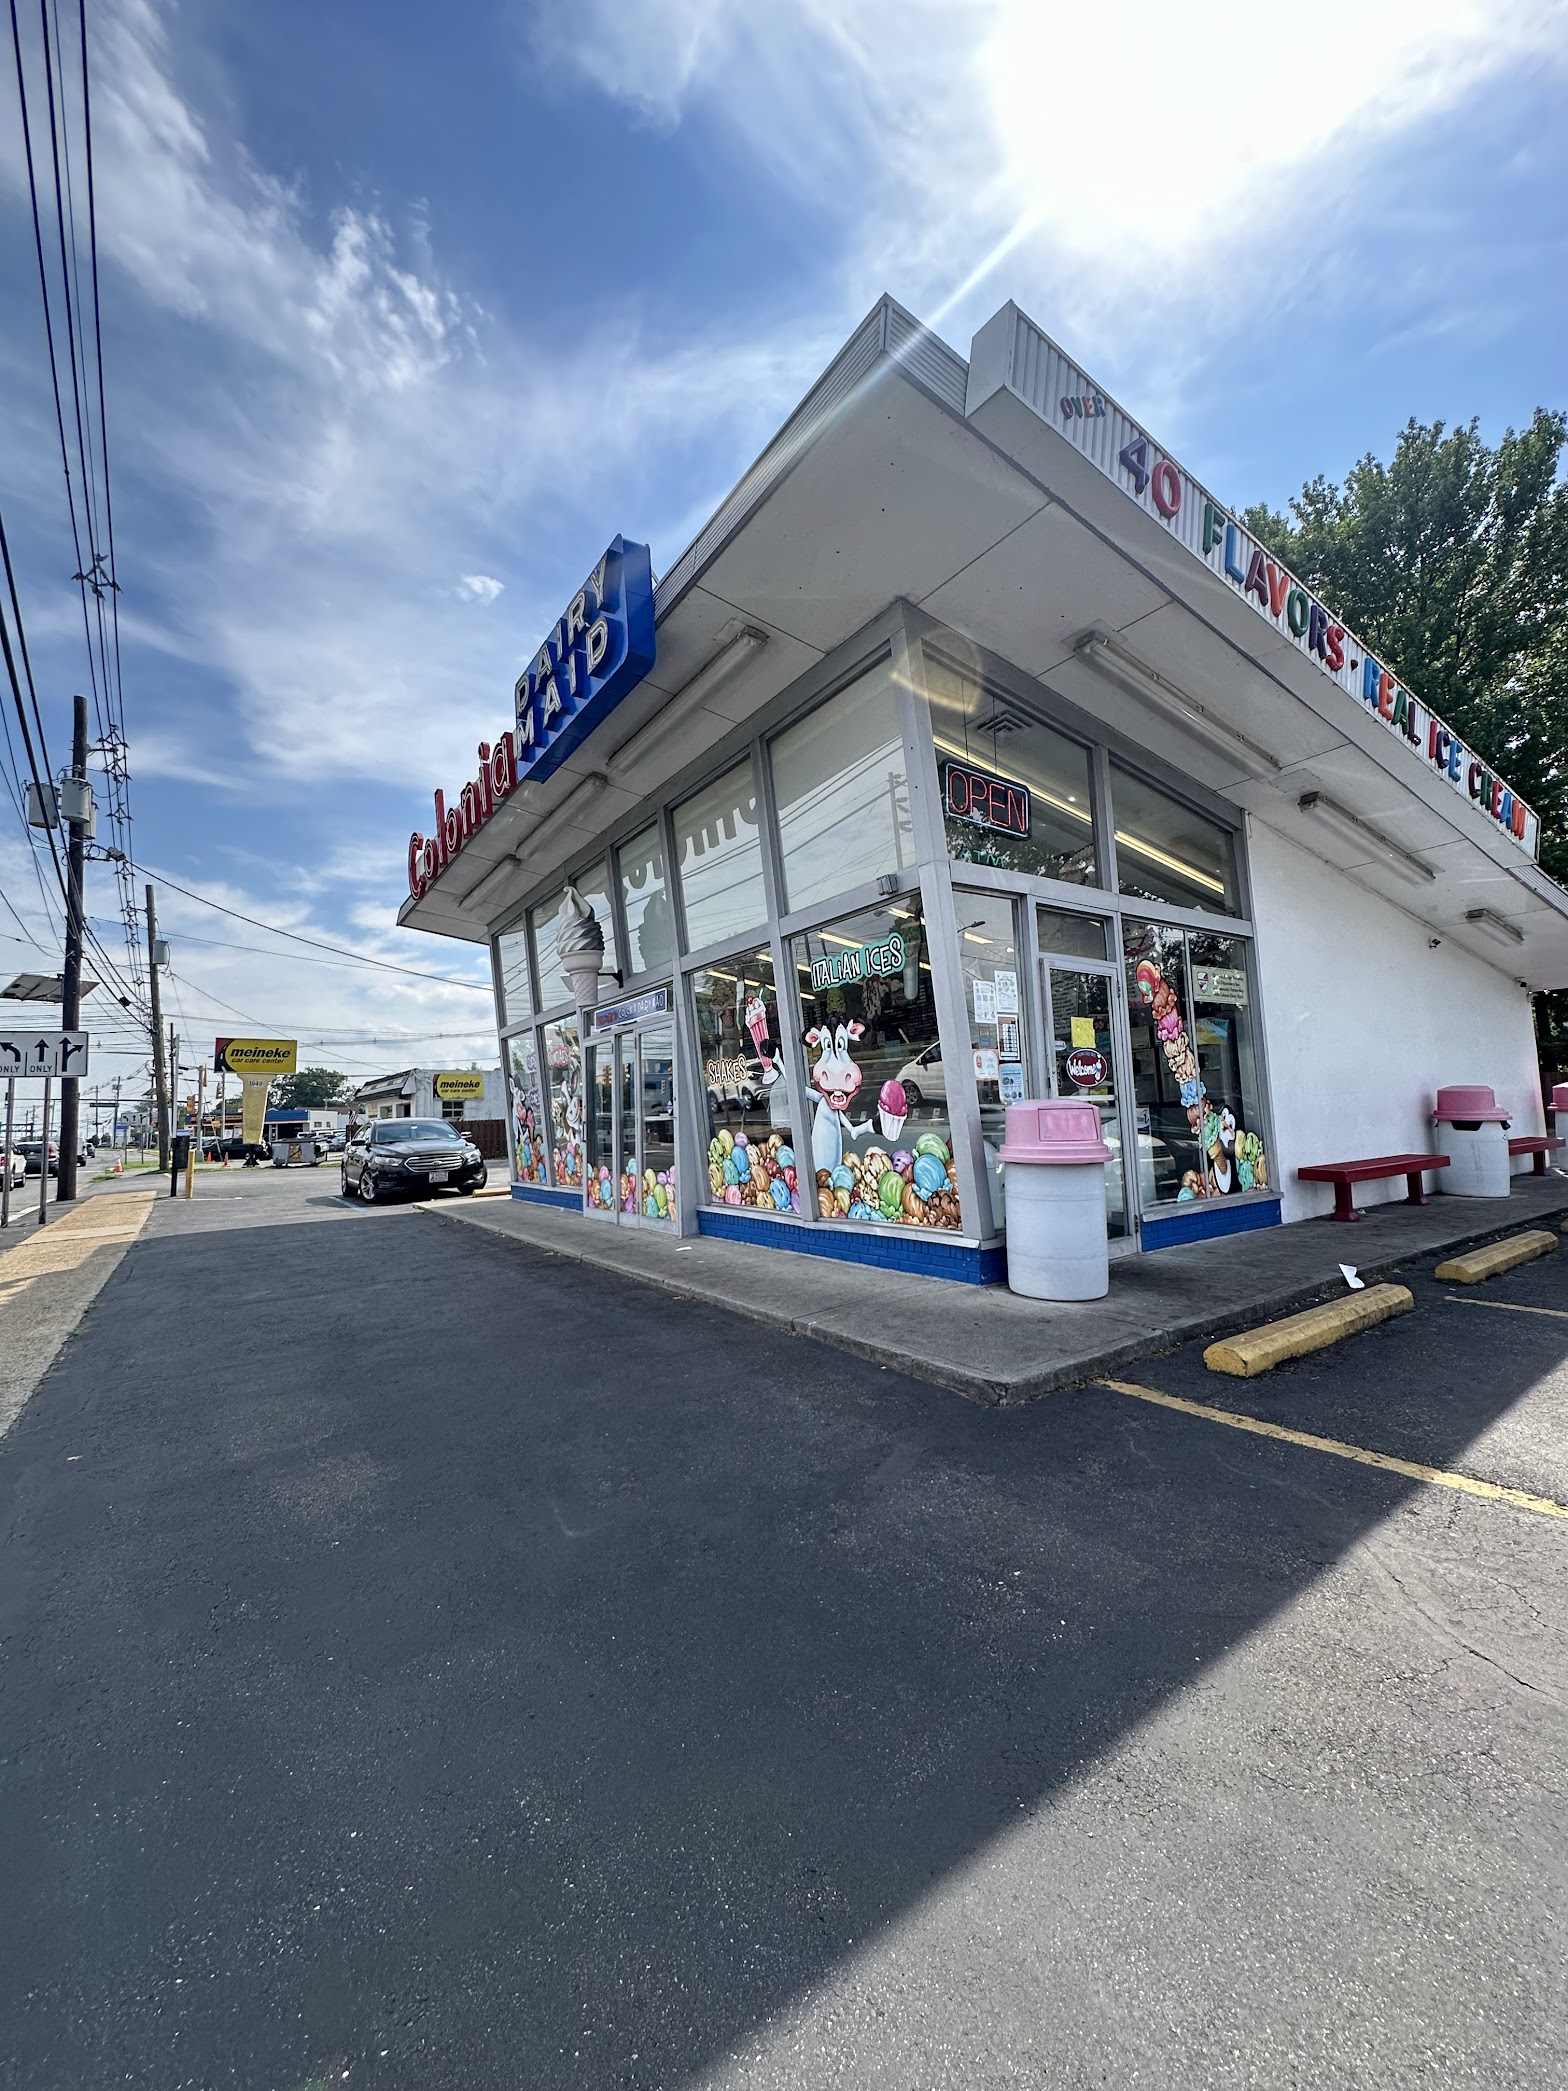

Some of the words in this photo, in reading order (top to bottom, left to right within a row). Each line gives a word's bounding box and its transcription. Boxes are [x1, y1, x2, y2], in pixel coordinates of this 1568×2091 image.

[1060, 395, 1107, 420] OVER
[515, 555, 609, 718] DAIRY
[1119, 436, 1182, 520] 40
[1203, 501, 1345, 672] FLAVORS
[1363, 656, 1421, 746] REAL
[1428, 719, 1463, 783] ICE
[1468, 762, 1526, 841] CREAM
[514, 615, 610, 759] MAID
[408, 732, 518, 901] Colonia
[949, 771, 1025, 832] OPEN
[960, 848, 1005, 867] ATM
[811, 951, 861, 989] ITALIAN
[865, 936, 904, 976] ICES
[30, 1065, 52, 1073] ONLY
[230, 1047, 291, 1058] meineke
[708, 1057, 748, 1086] SHAKES
[440, 1080, 480, 1088] meineke
